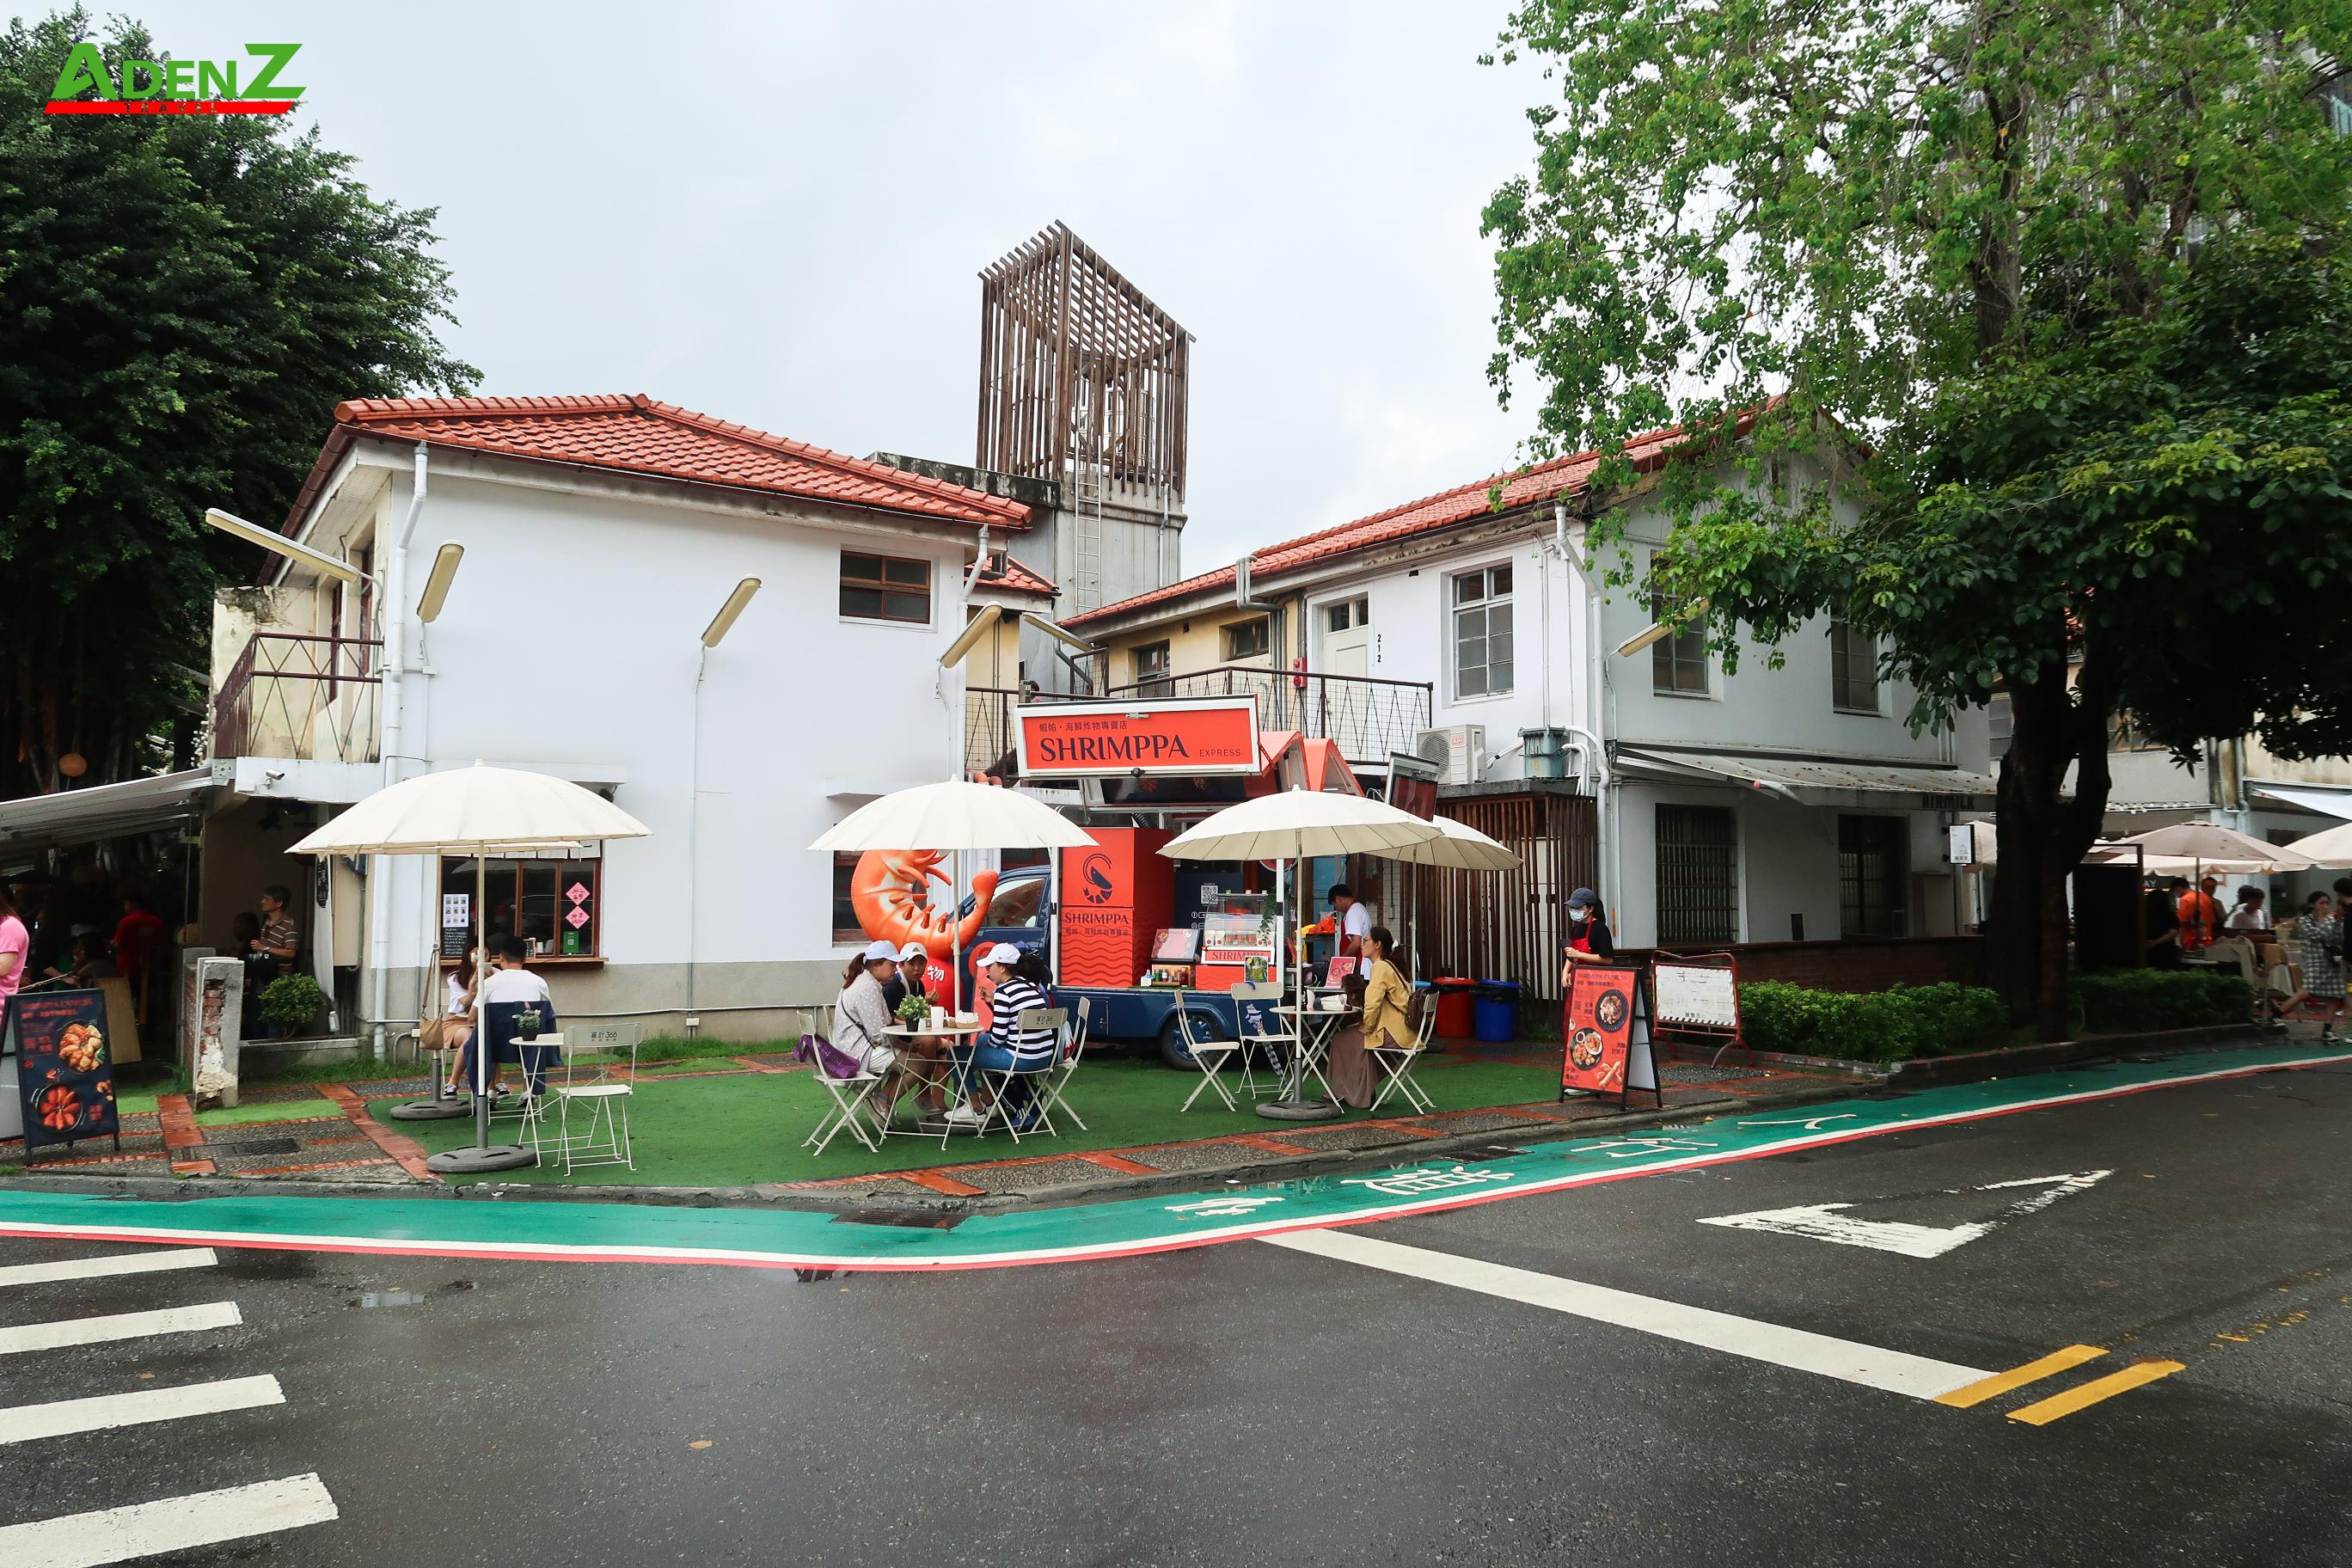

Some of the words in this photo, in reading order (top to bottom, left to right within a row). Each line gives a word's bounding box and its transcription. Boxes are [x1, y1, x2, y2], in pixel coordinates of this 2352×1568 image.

[1039, 734, 1190, 762] SHRIMPPA
[1199, 748, 1241, 757] EXPRESS
[1064, 912, 1130, 925] SHRIMPPA
[1212, 950, 1265, 960] SHRIM
